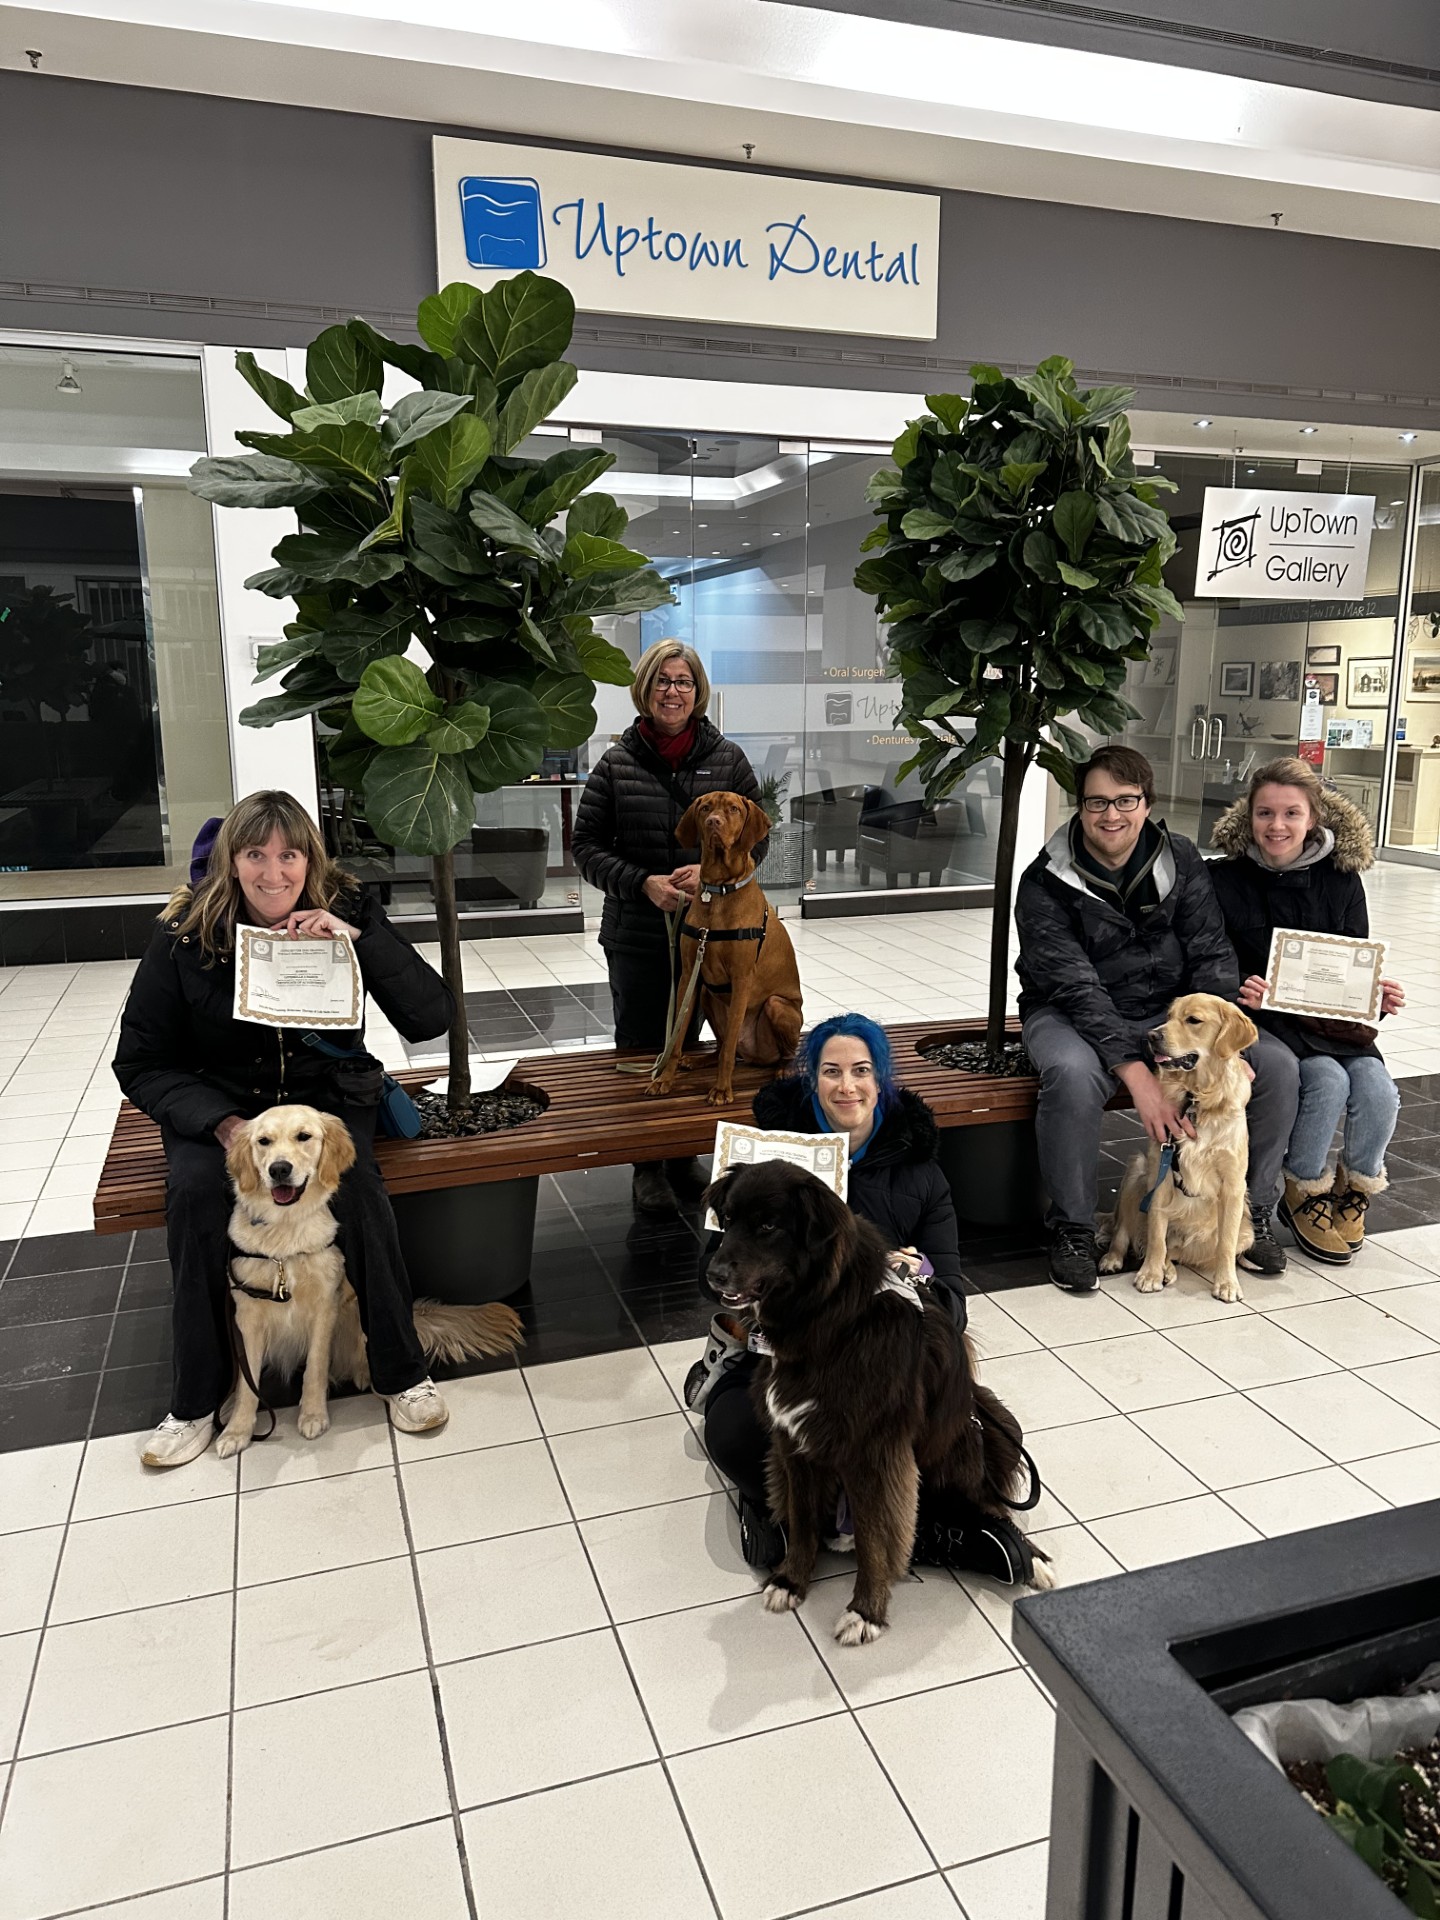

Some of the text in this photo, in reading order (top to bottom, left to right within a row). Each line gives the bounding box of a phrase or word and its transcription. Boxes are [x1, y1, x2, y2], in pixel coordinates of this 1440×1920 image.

[552, 198, 920, 286] Uptown Dental
[1270, 506, 1358, 538] UpTown
[1265, 555, 1350, 588] Gallery
[1365, 602, 1377, 615] 12
[829, 666, 886, 680] Oral Surger
[872, 734, 915, 745] Dentures
